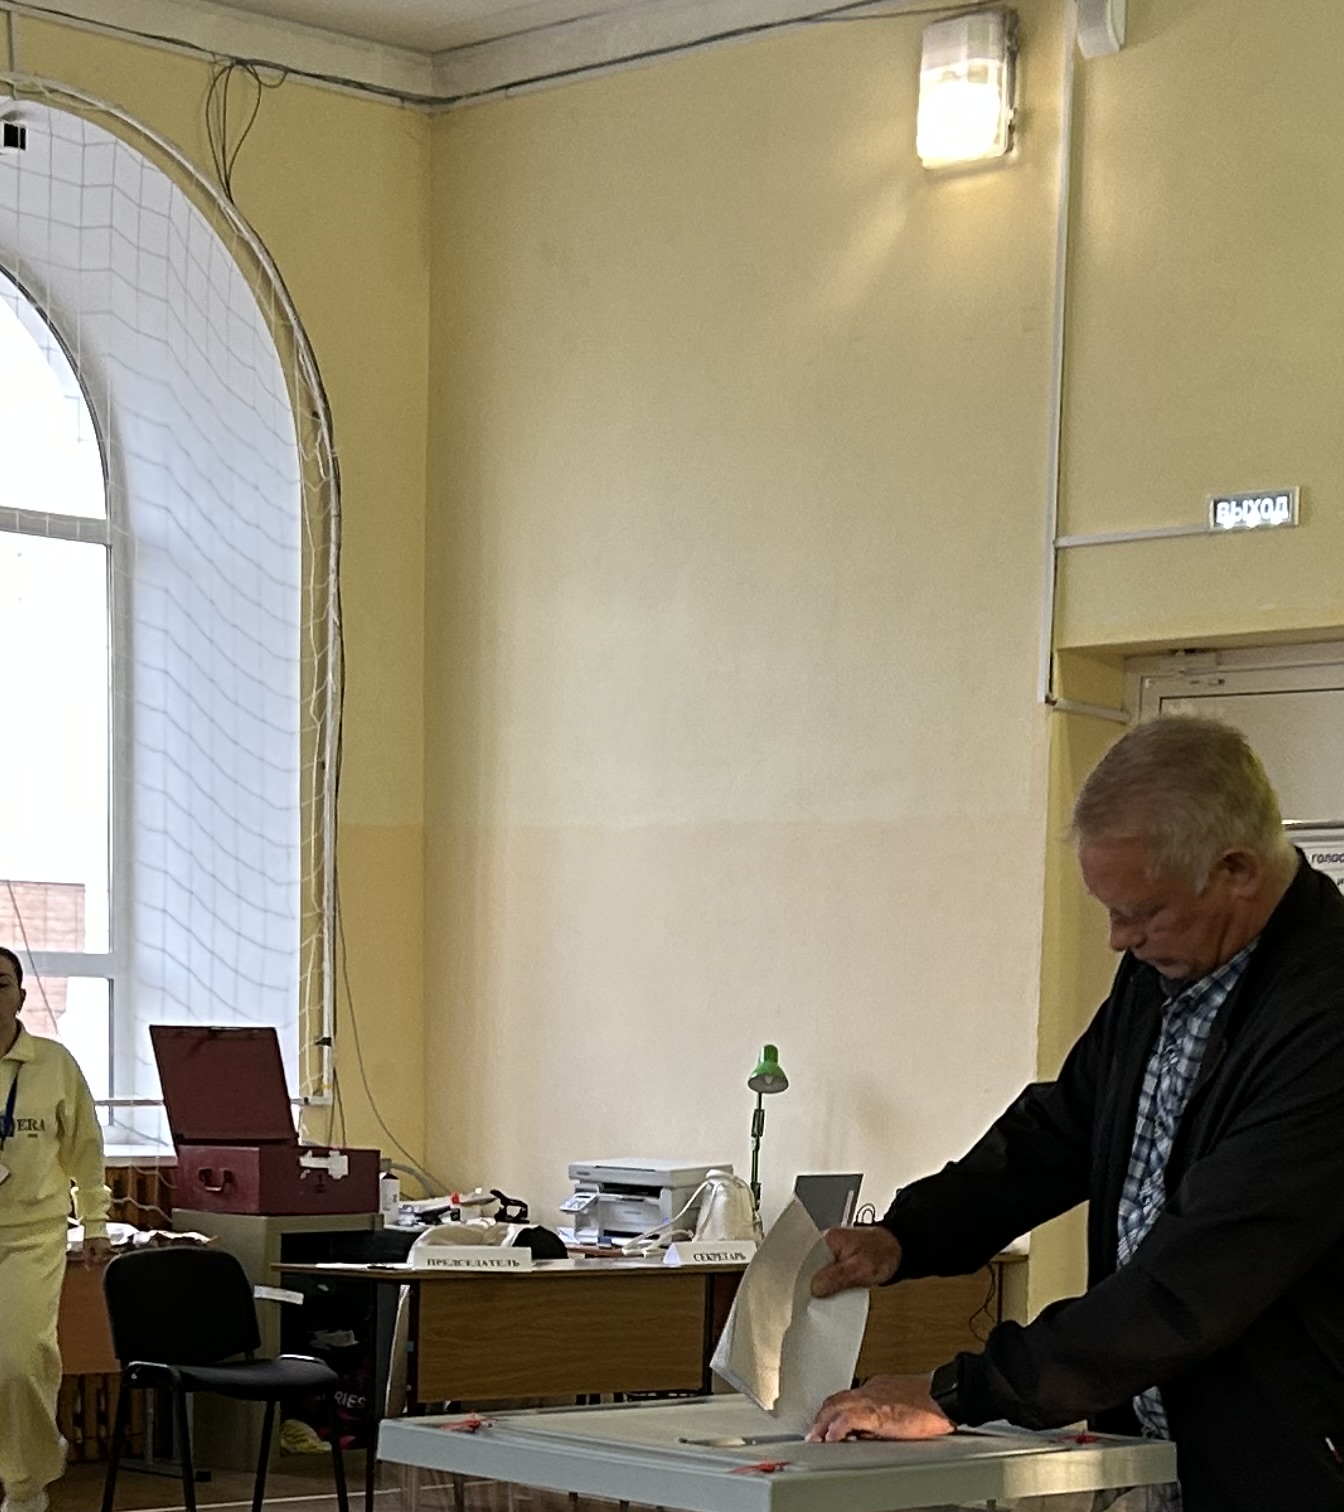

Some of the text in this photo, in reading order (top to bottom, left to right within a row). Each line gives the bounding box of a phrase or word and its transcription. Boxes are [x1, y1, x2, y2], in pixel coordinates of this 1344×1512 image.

[1216, 496, 1289, 525] ВЫХОД
[17, 1118, 46, 1132] ERA
[427, 1258, 521, 1268] ПРЕДСЕДАТЕЛЬ
